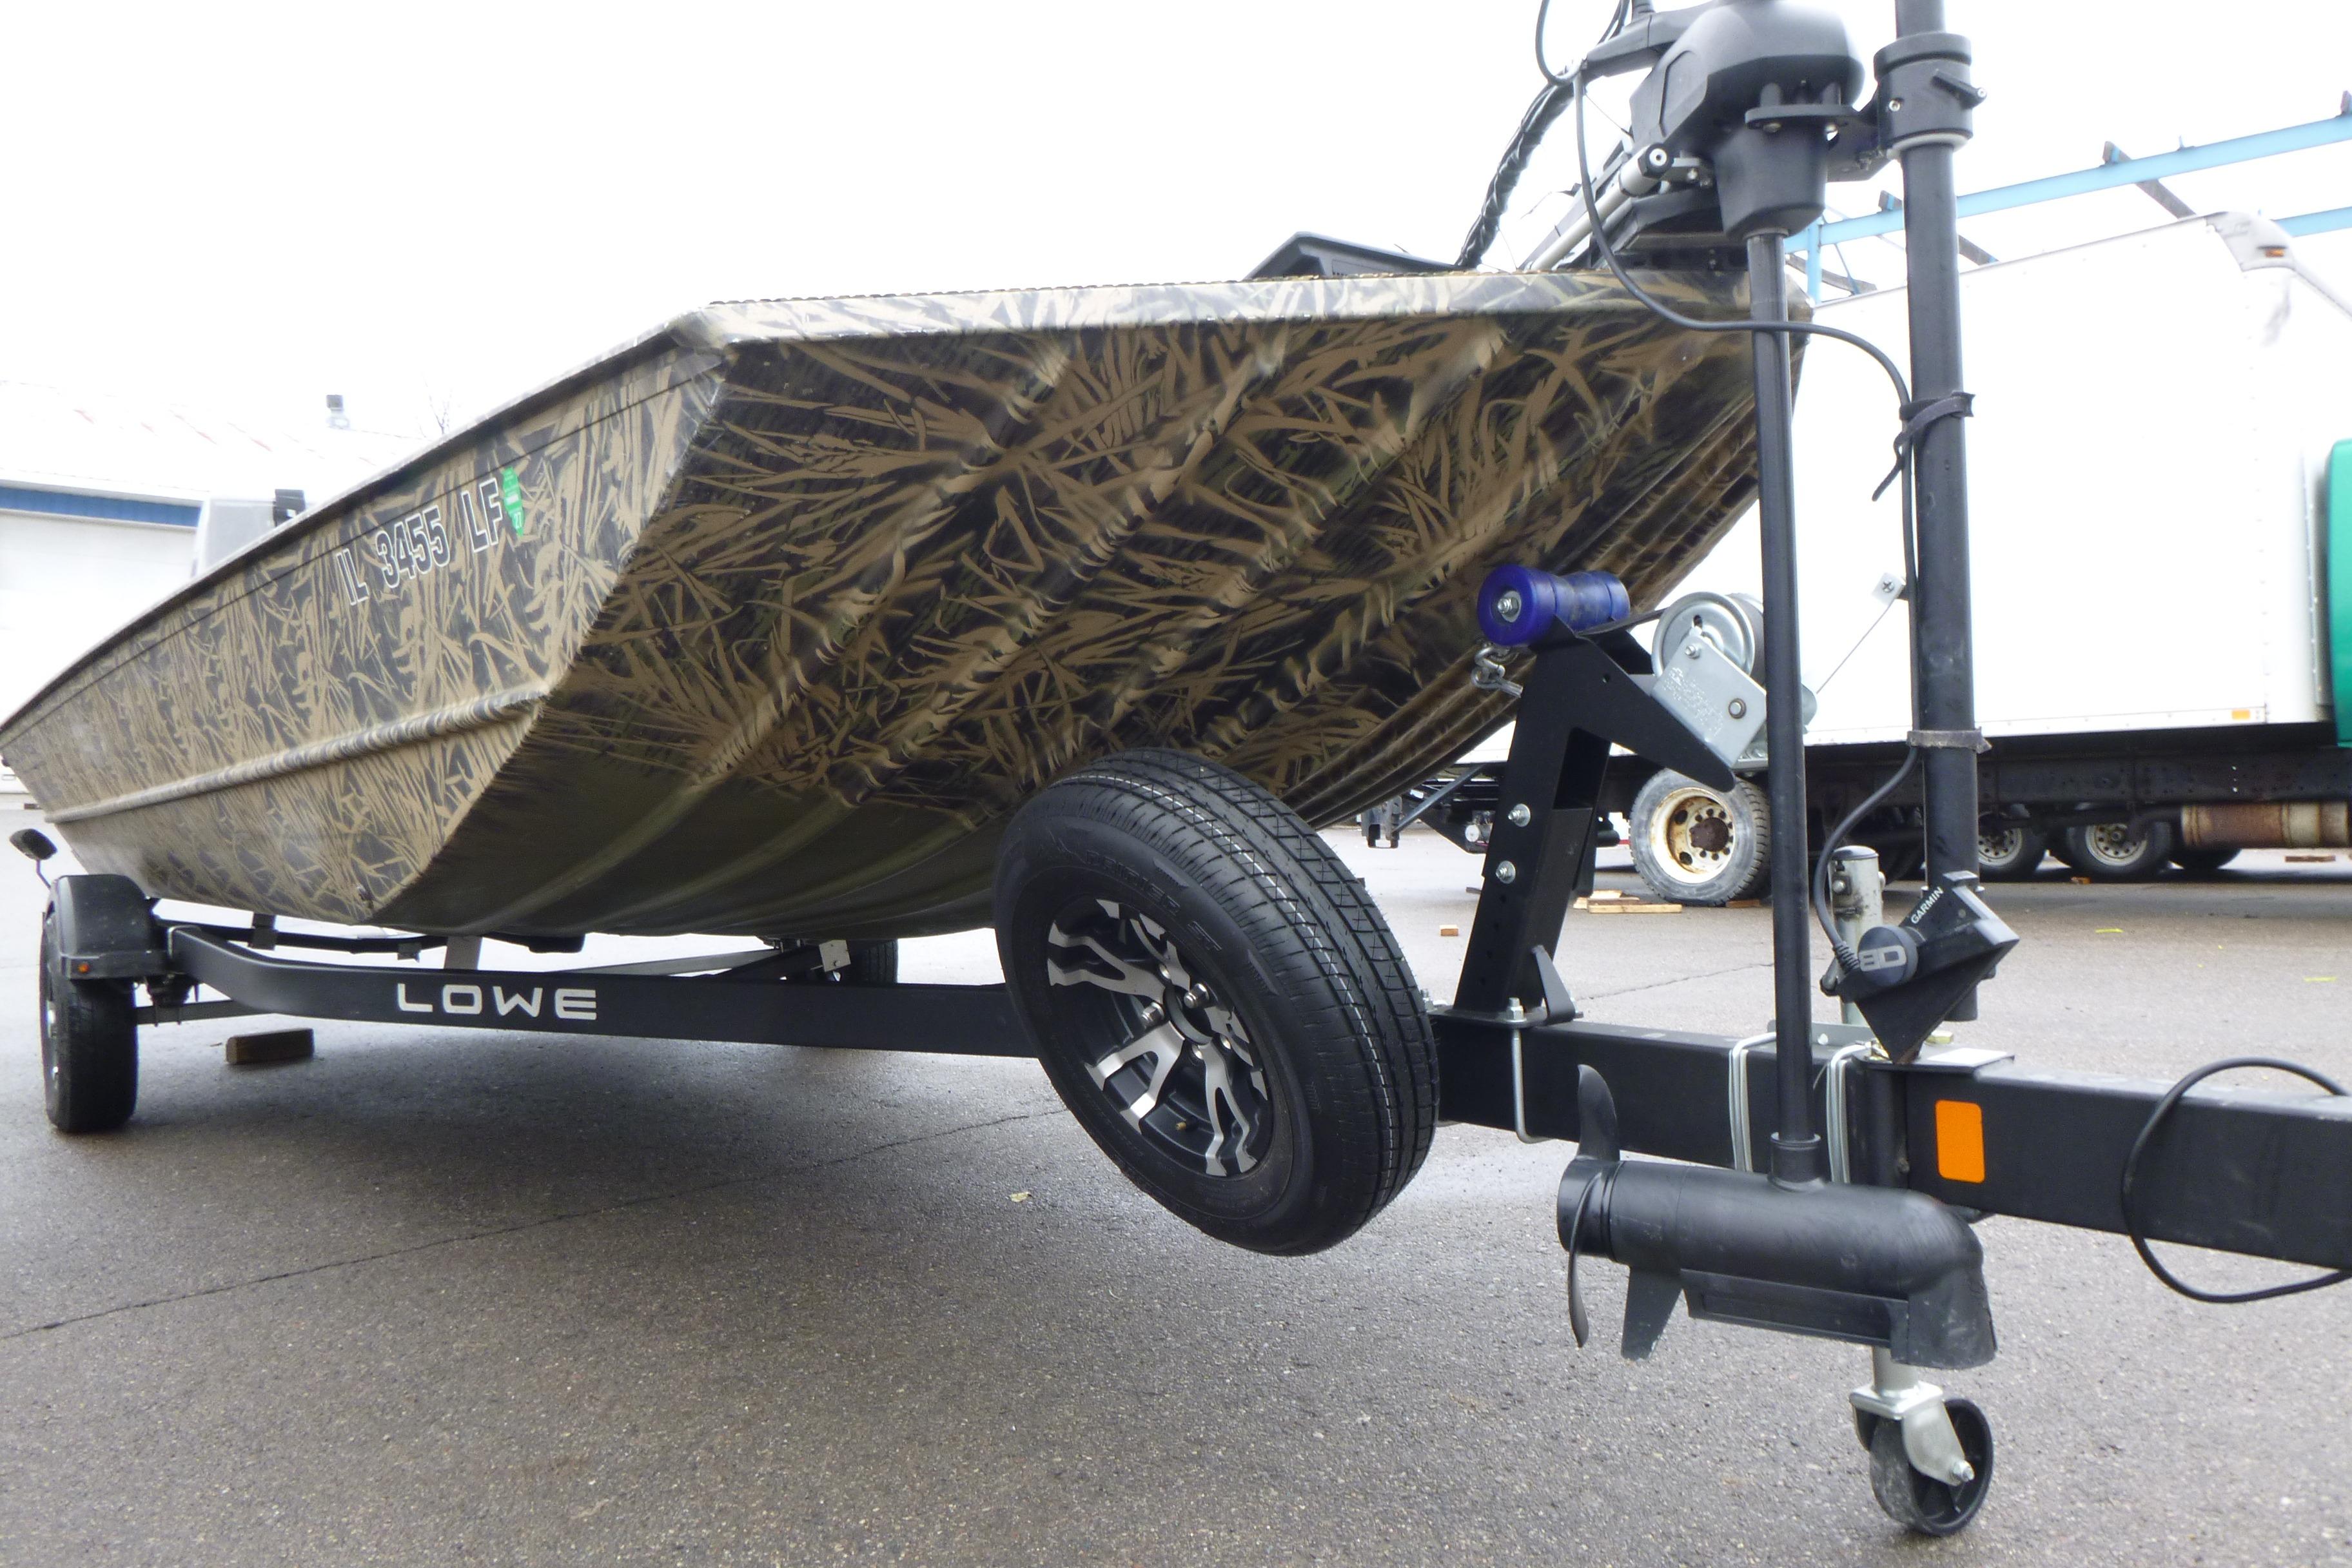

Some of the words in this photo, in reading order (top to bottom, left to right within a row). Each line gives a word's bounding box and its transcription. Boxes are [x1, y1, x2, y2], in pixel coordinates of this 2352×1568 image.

[337, 548, 369, 606] IL
[375, 505, 451, 589] 3455
[461, 477, 503, 553] LF
[1910, 886, 1944, 924] GARMIN
[397, 983, 597, 1021] LOWE
